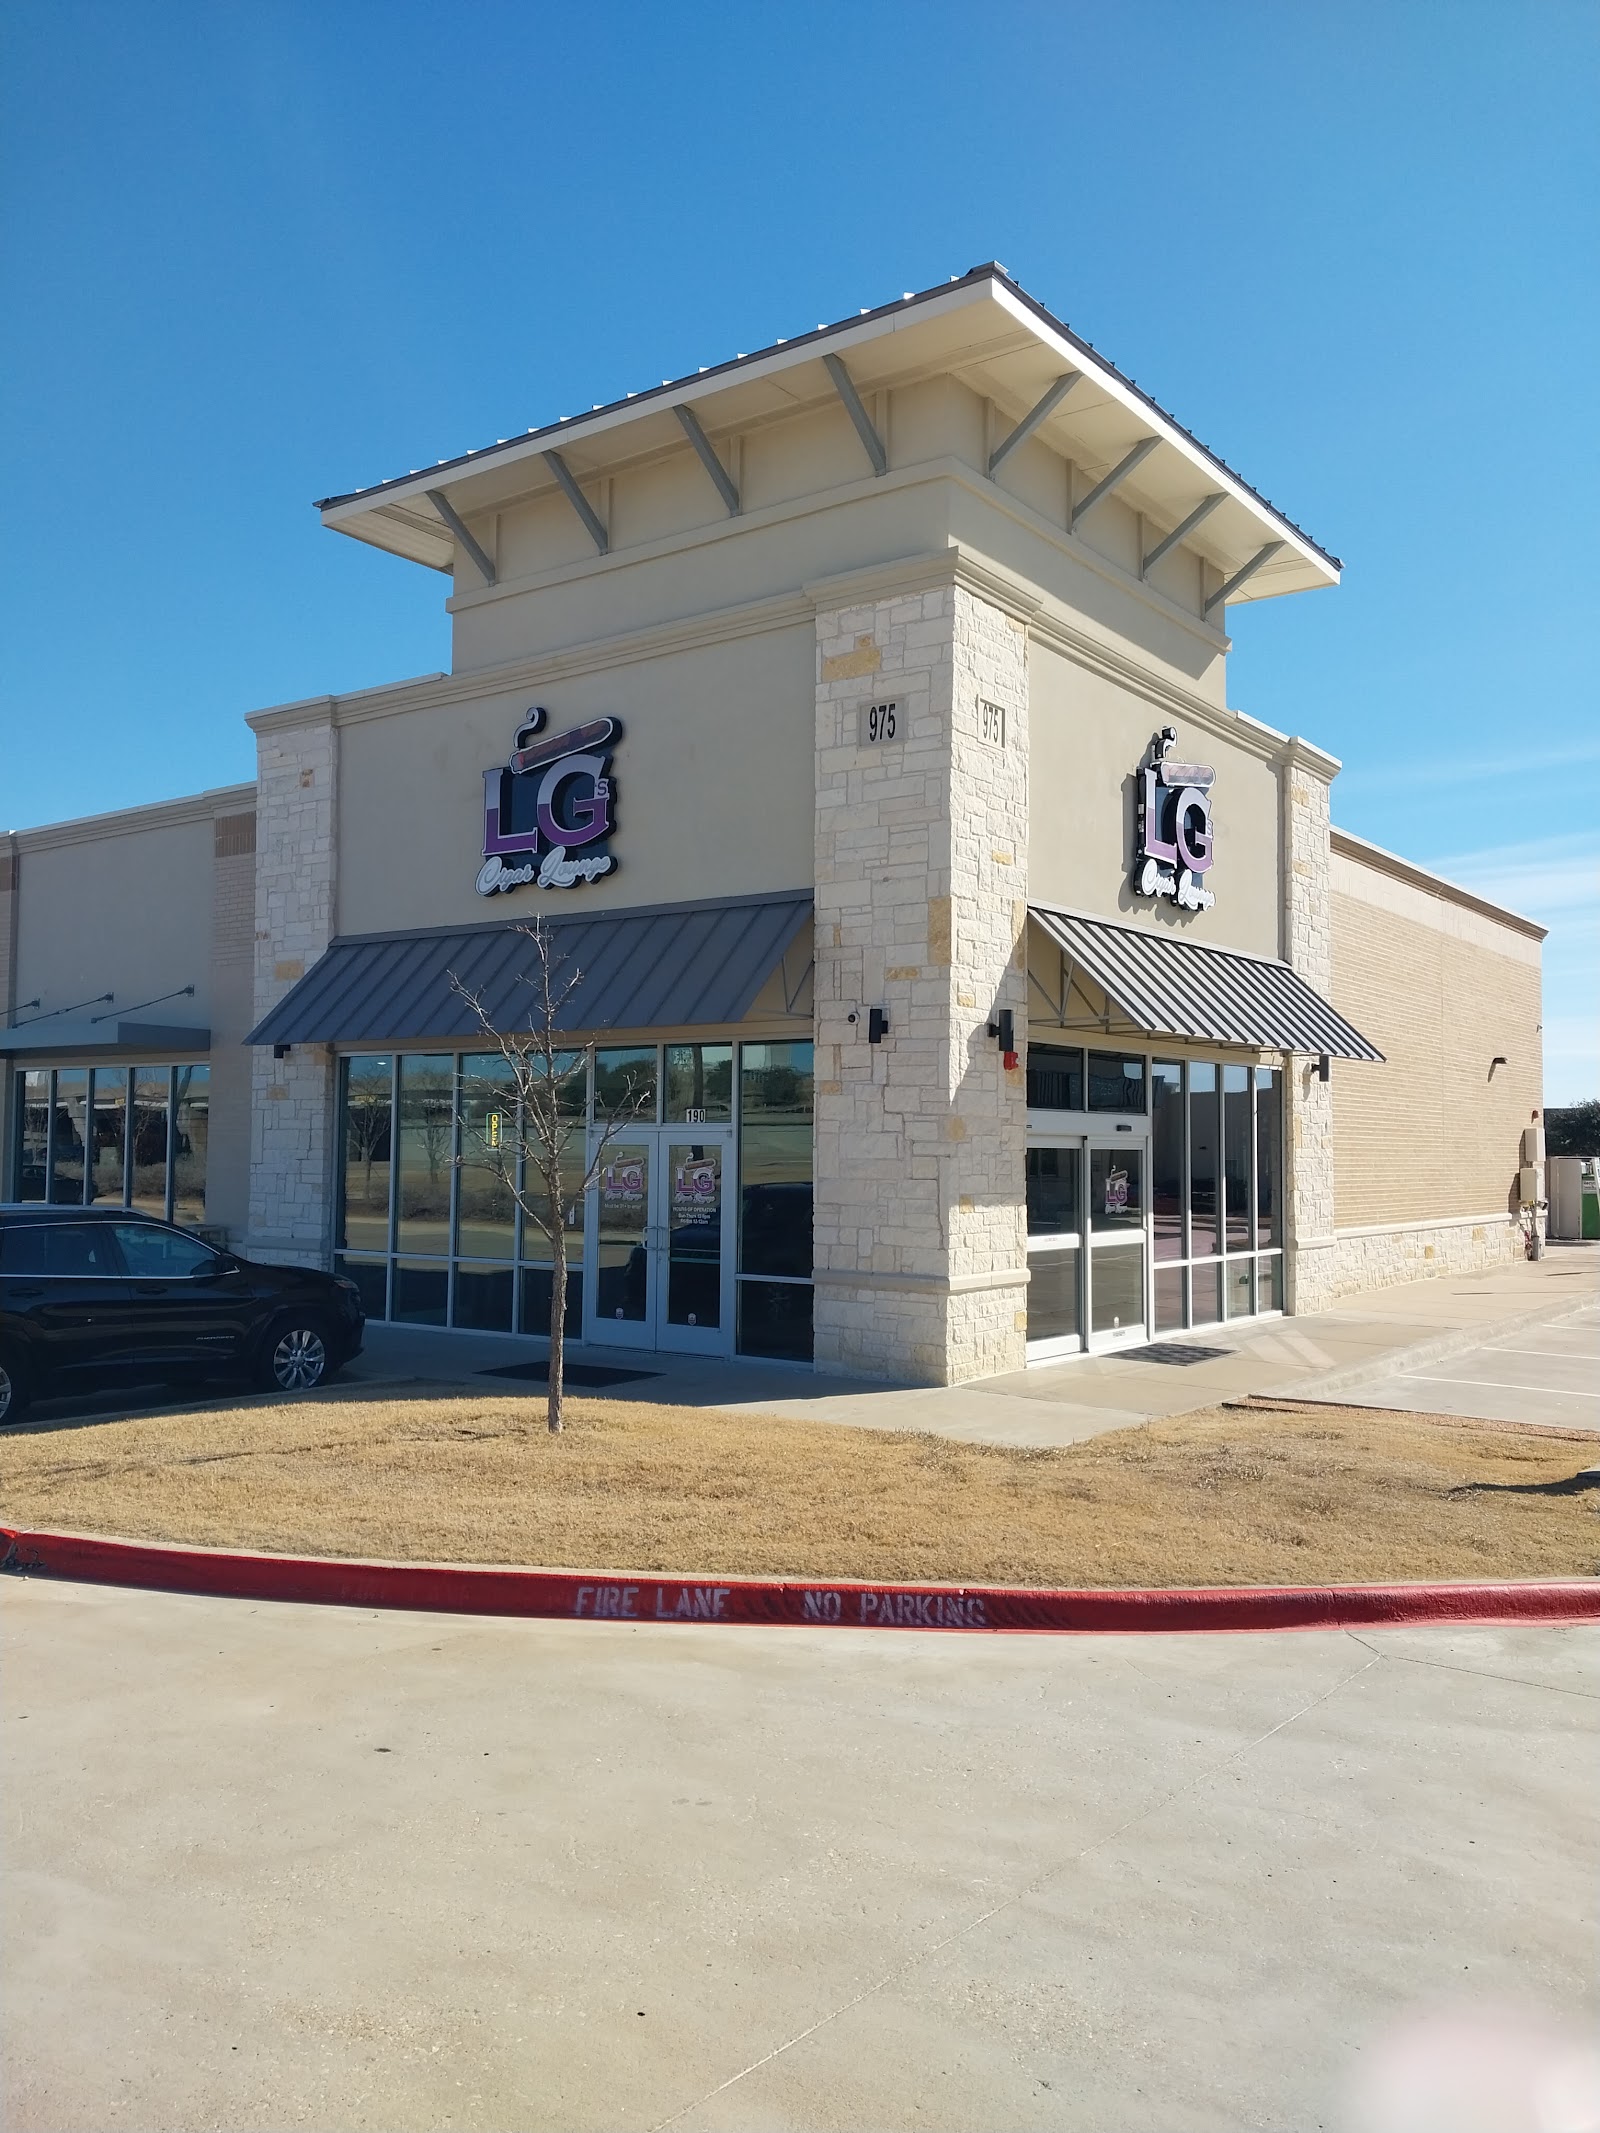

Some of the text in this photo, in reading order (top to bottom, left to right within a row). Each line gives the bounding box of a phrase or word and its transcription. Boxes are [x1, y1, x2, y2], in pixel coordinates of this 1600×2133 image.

[869, 703, 896, 741] 975
[983, 703, 999, 743] 975
[475, 846, 611, 895] Cigar Lounge
[1142, 859, 1216, 911] Cigar Lounge
[688, 1109, 704, 1122] 190
[575, 1587, 987, 1628] FIRE LANE NO PARKING
